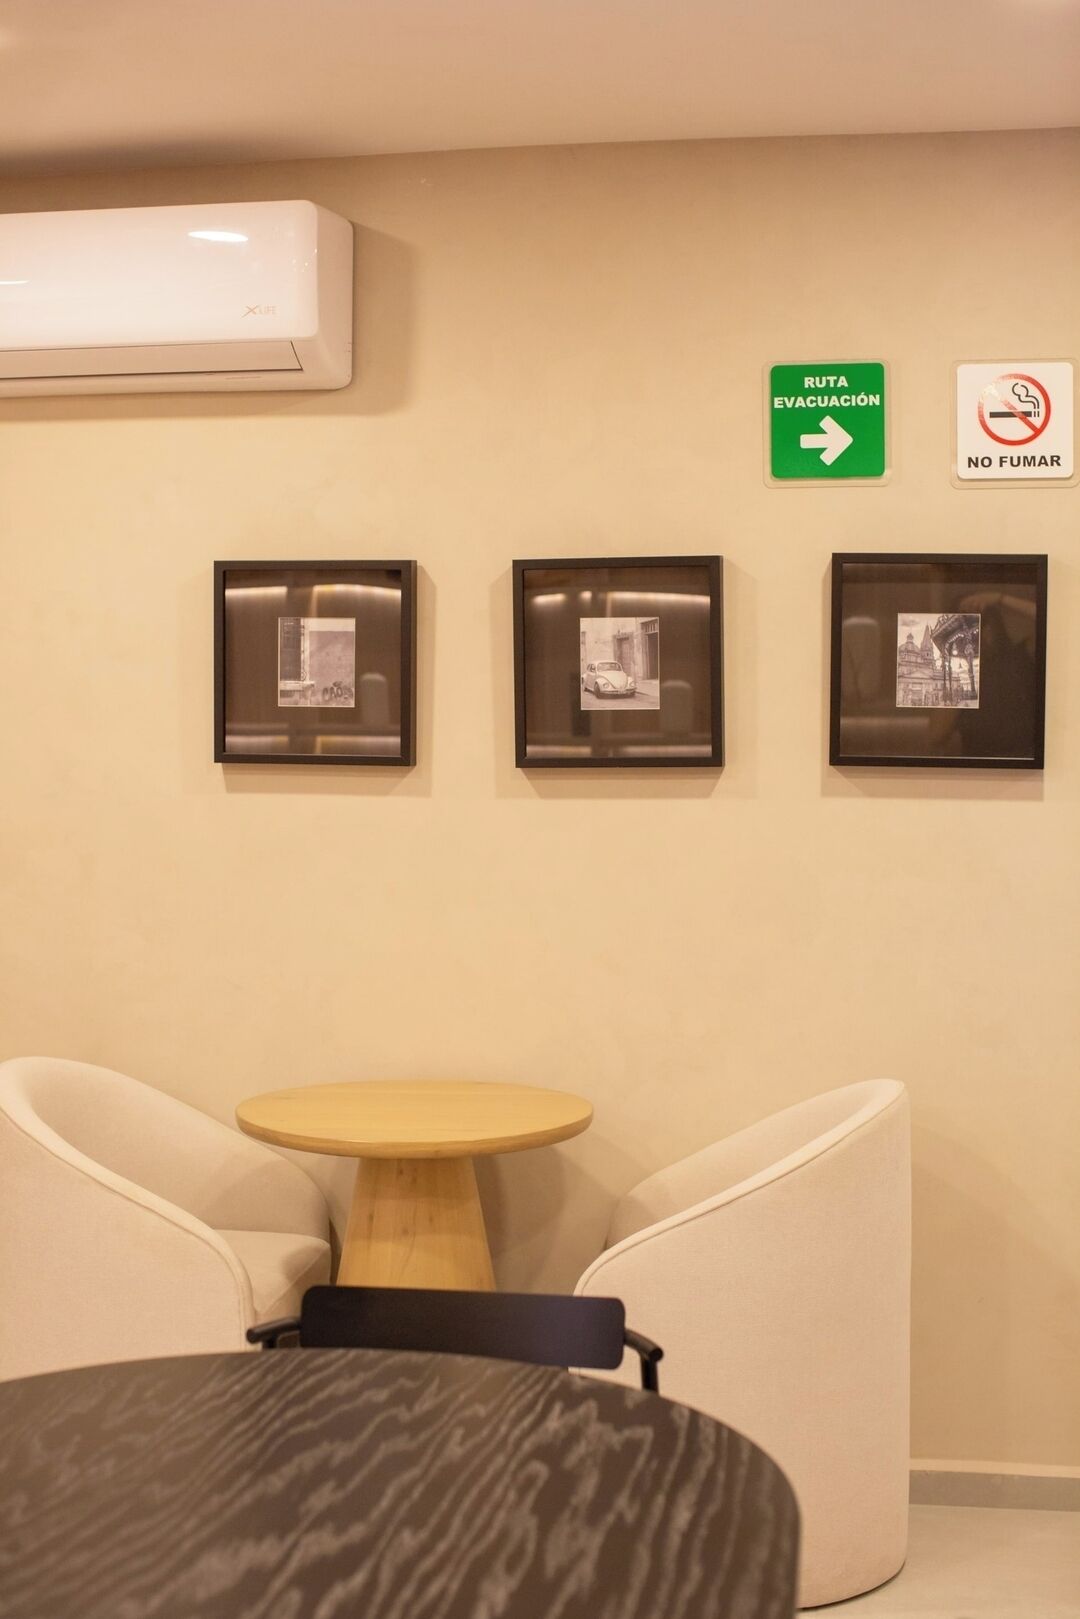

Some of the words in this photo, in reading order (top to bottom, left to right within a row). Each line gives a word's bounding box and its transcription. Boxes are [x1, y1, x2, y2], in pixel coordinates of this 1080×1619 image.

[803, 376, 848, 389] RUTA
[773, 392, 880, 409] EVACUACIÓN
[967, 456, 993, 469] NO
[998, 455, 1062, 468] FUMAR
